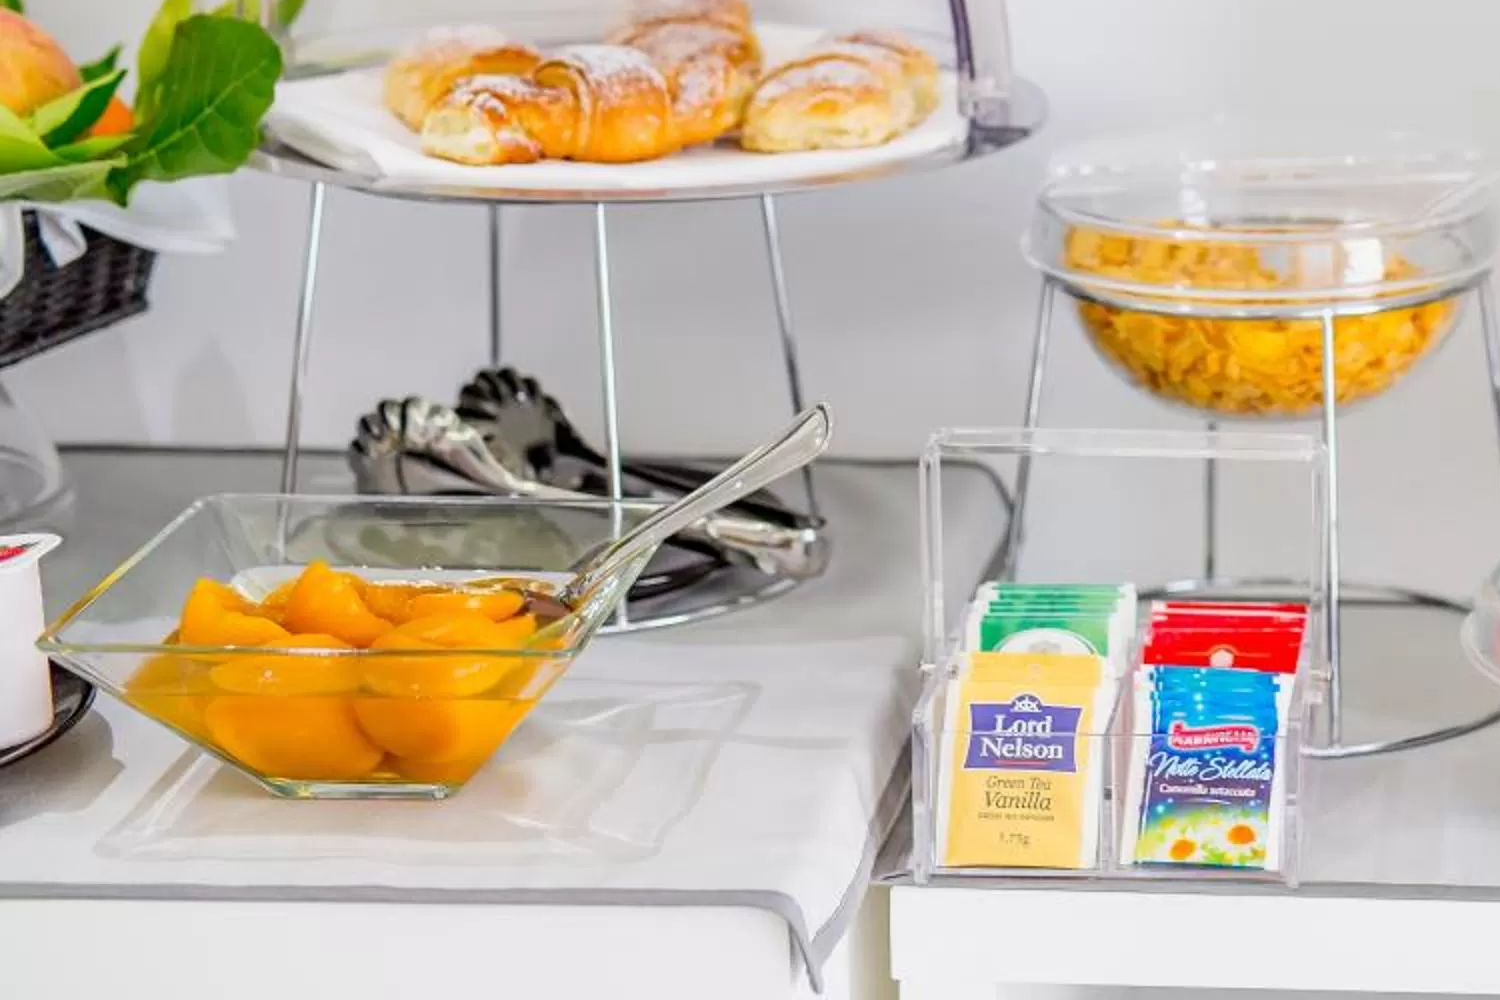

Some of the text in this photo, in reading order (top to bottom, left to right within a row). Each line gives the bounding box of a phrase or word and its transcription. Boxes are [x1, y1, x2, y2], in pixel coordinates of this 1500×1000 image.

[994, 713, 1053, 737] Lord
[979, 737, 1064, 759] Nelson
[986, 776, 1052, 790] Green Tea
[984, 791, 1053, 811] Vanilla
